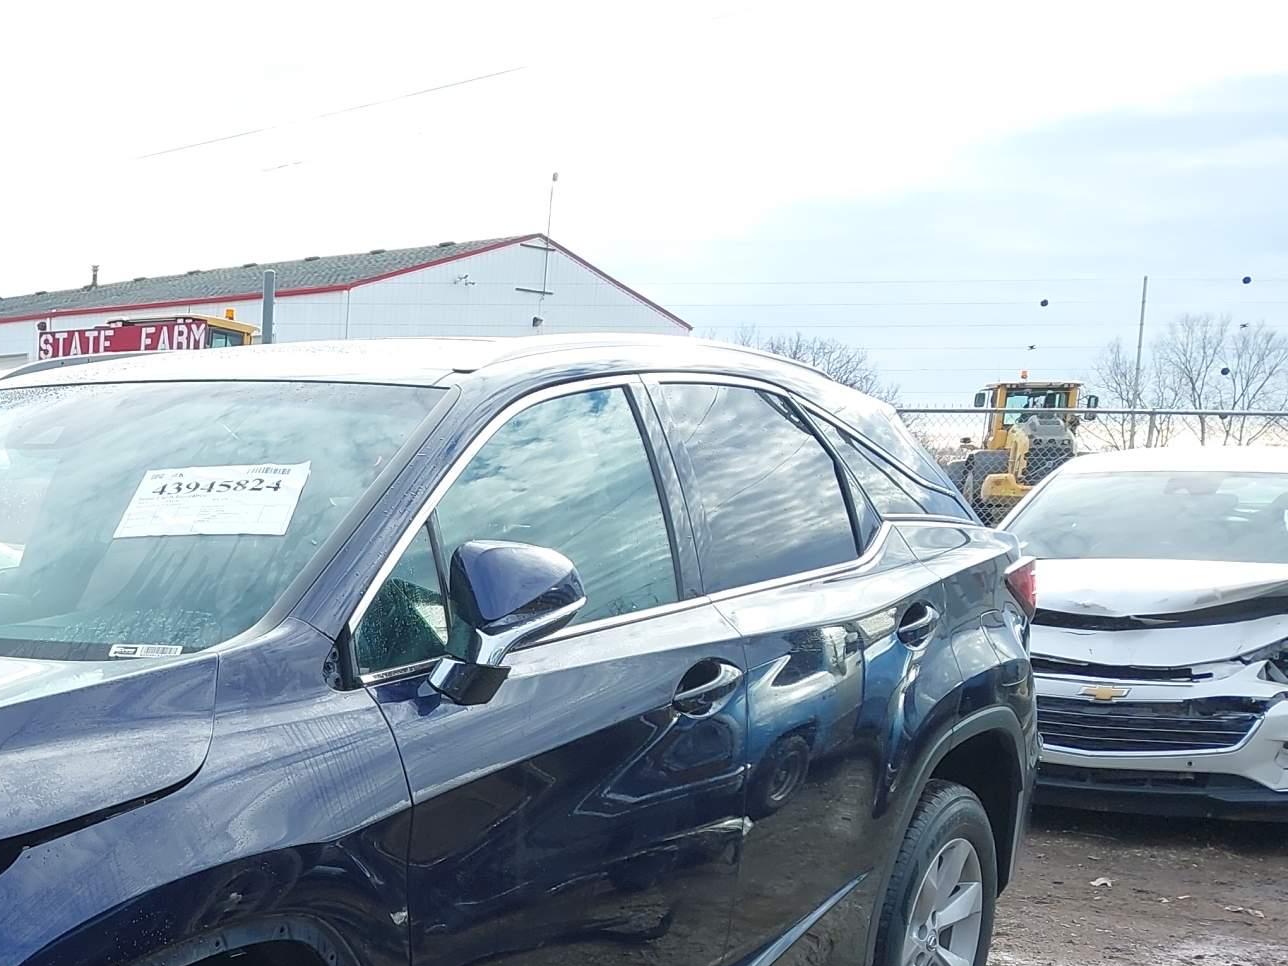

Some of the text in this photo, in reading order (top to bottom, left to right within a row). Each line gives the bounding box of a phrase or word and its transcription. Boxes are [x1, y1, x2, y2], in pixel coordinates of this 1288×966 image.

[40, 323, 206, 359] STATE FARM
[152, 478, 282, 495] 43945824
